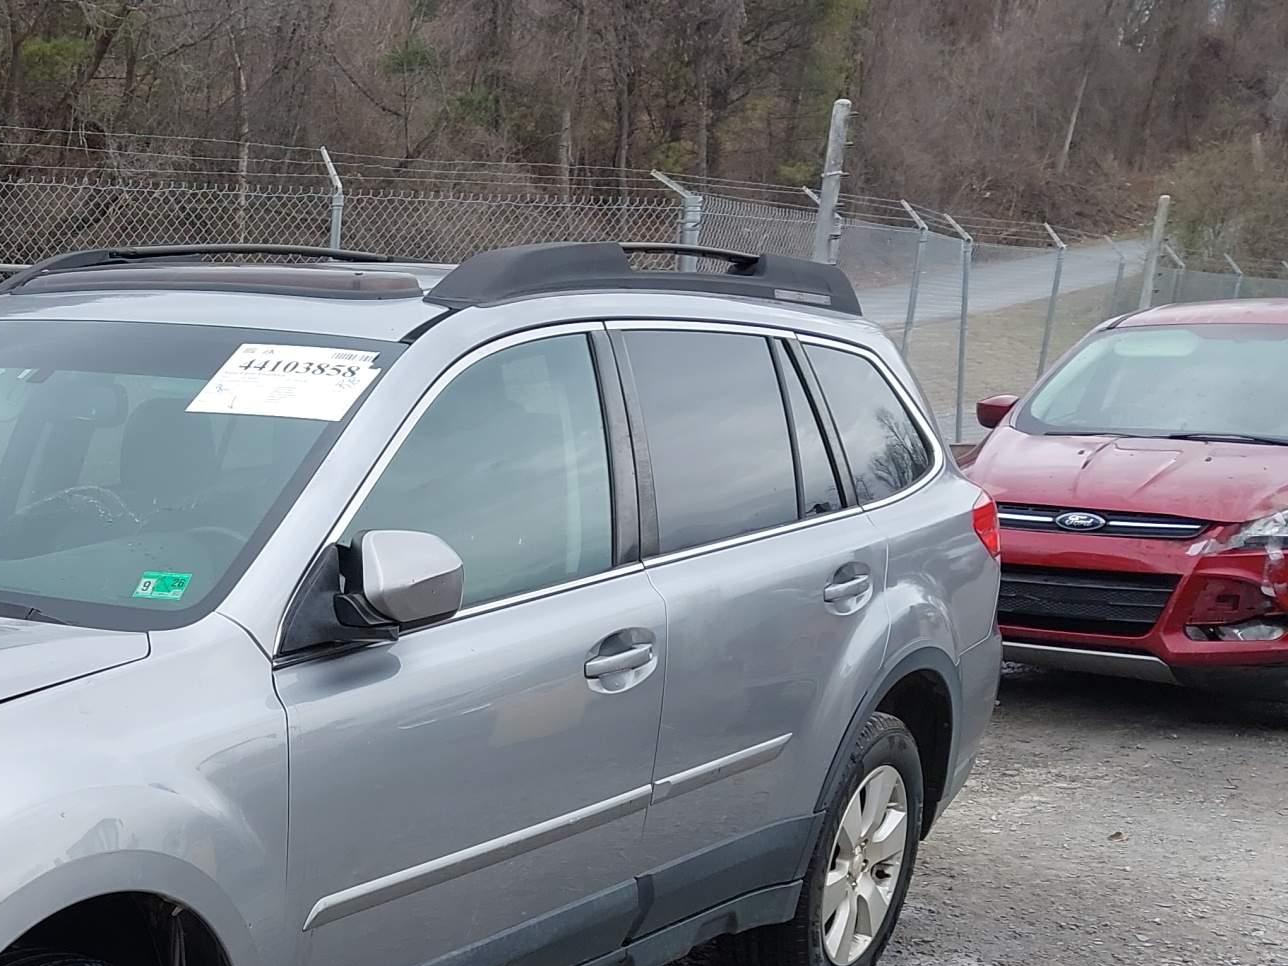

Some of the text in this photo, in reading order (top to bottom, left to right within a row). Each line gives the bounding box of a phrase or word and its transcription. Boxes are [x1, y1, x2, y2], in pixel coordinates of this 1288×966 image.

[239, 359, 361, 378] 44103858
[1065, 515, 1094, 526] Ford
[141, 578, 186, 592] 9 26
